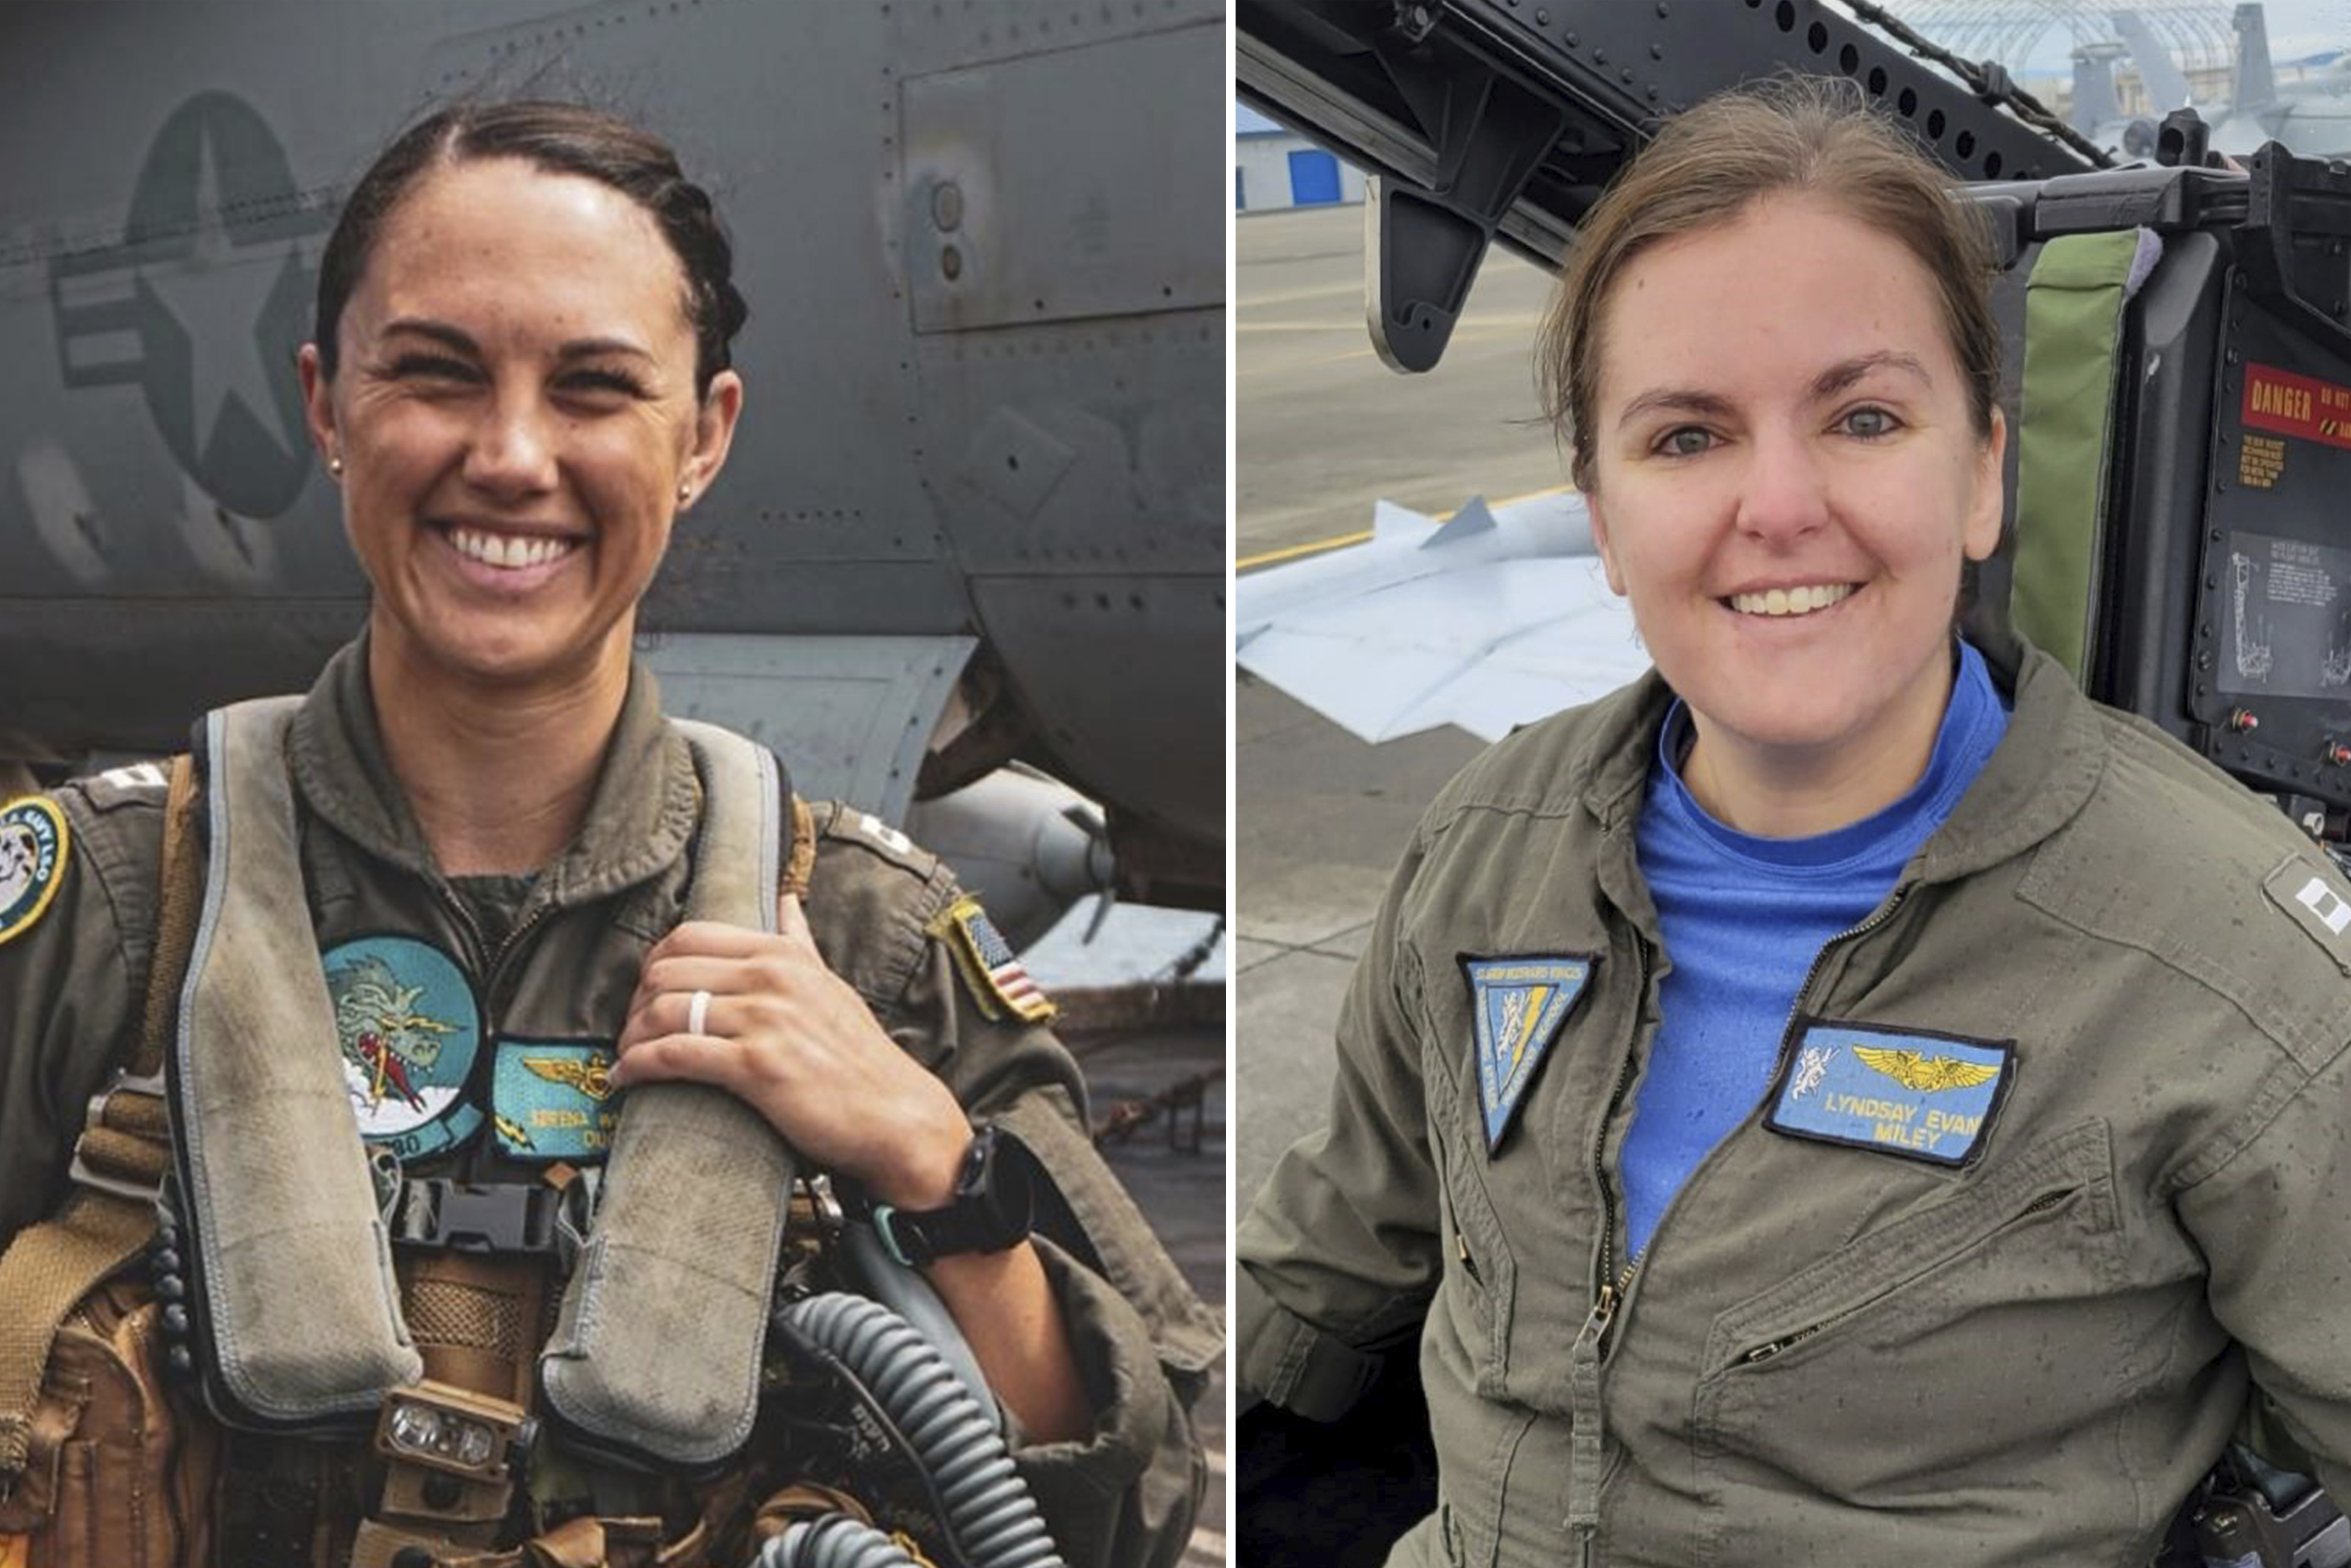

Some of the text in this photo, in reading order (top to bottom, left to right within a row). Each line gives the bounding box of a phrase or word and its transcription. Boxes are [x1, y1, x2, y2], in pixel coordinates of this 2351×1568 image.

[2251, 379, 2312, 422] DANGER
[1825, 1091, 1918, 1122] LYNDSAY
[1874, 1122, 1941, 1150] MILEY
